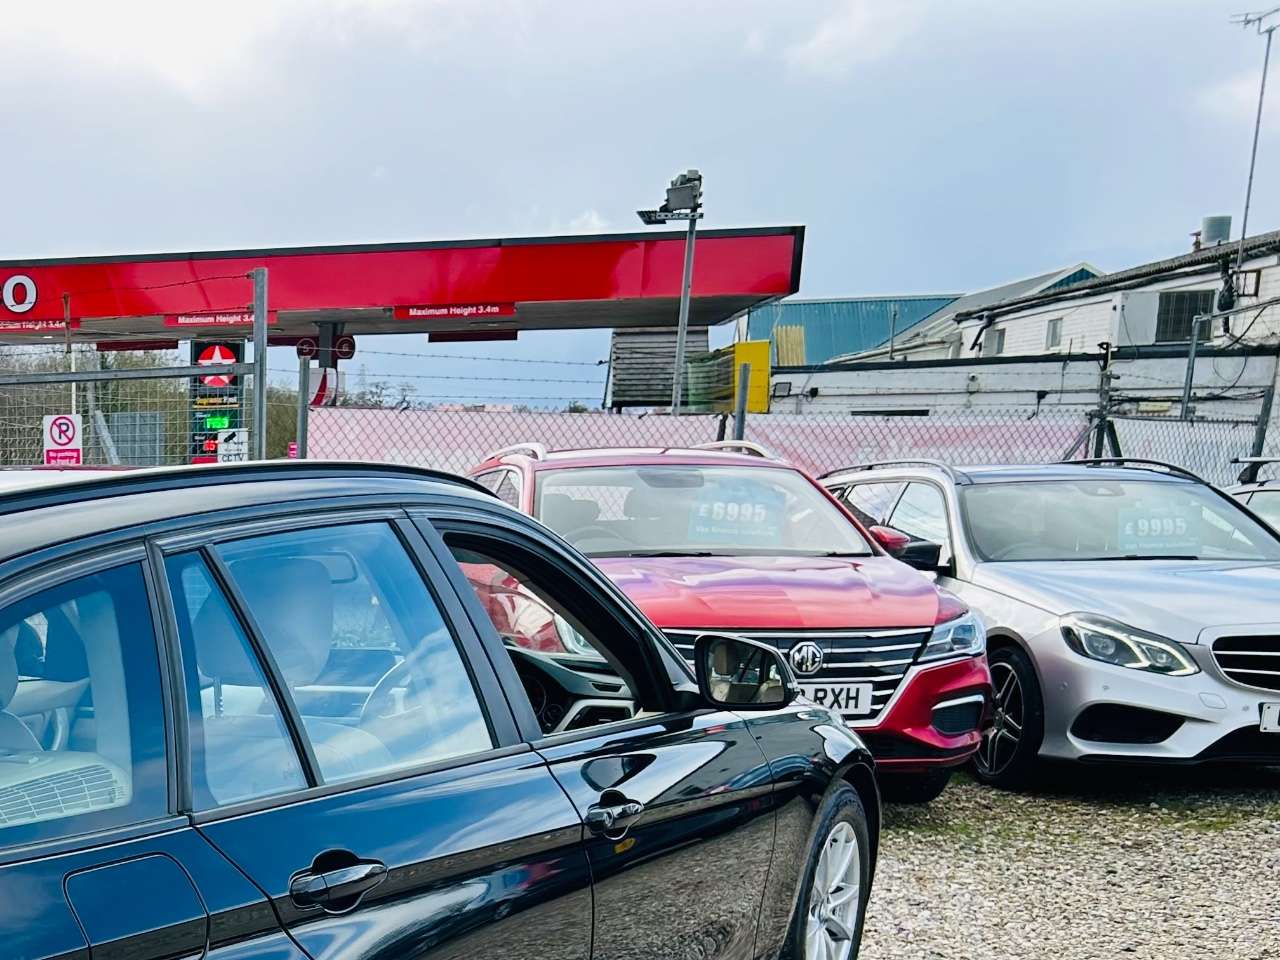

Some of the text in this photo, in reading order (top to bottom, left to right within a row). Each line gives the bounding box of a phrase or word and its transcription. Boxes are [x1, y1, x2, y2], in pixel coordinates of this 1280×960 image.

[216, 314, 241, 323] Height
[243, 314, 255, 322] 3.4
[409, 305, 499, 316] Maximum Height 3.4m
[793, 645, 821, 671] MG
[813, 687, 860, 709] RXH
